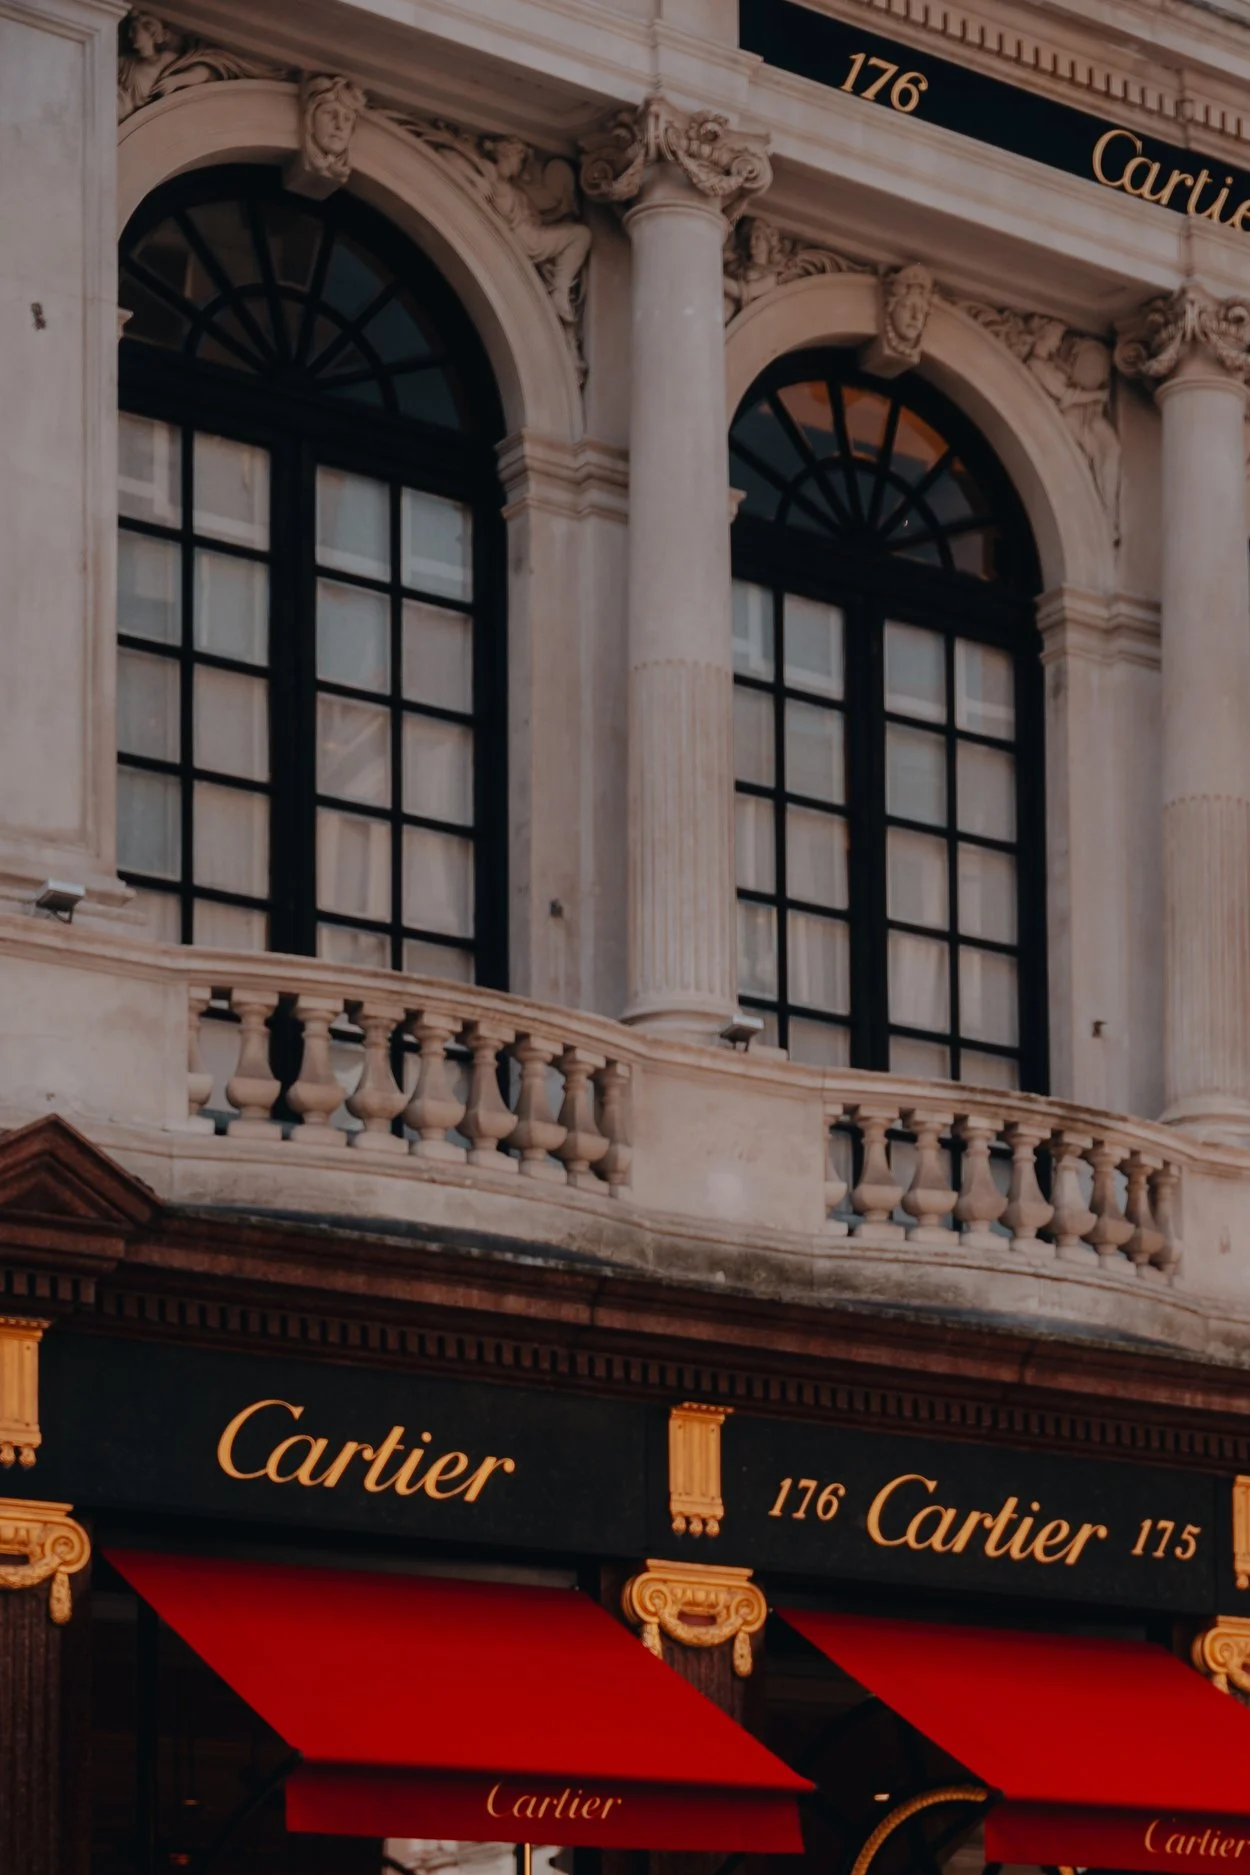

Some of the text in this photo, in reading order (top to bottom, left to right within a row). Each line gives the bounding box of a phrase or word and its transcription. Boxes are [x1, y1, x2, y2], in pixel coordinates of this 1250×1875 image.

[841, 52, 929, 115] 176
[216, 1399, 516, 1503] Cartier
[768, 1473, 1202, 1566] 176 Cartier 175
[486, 1783, 622, 1821] Cartier
